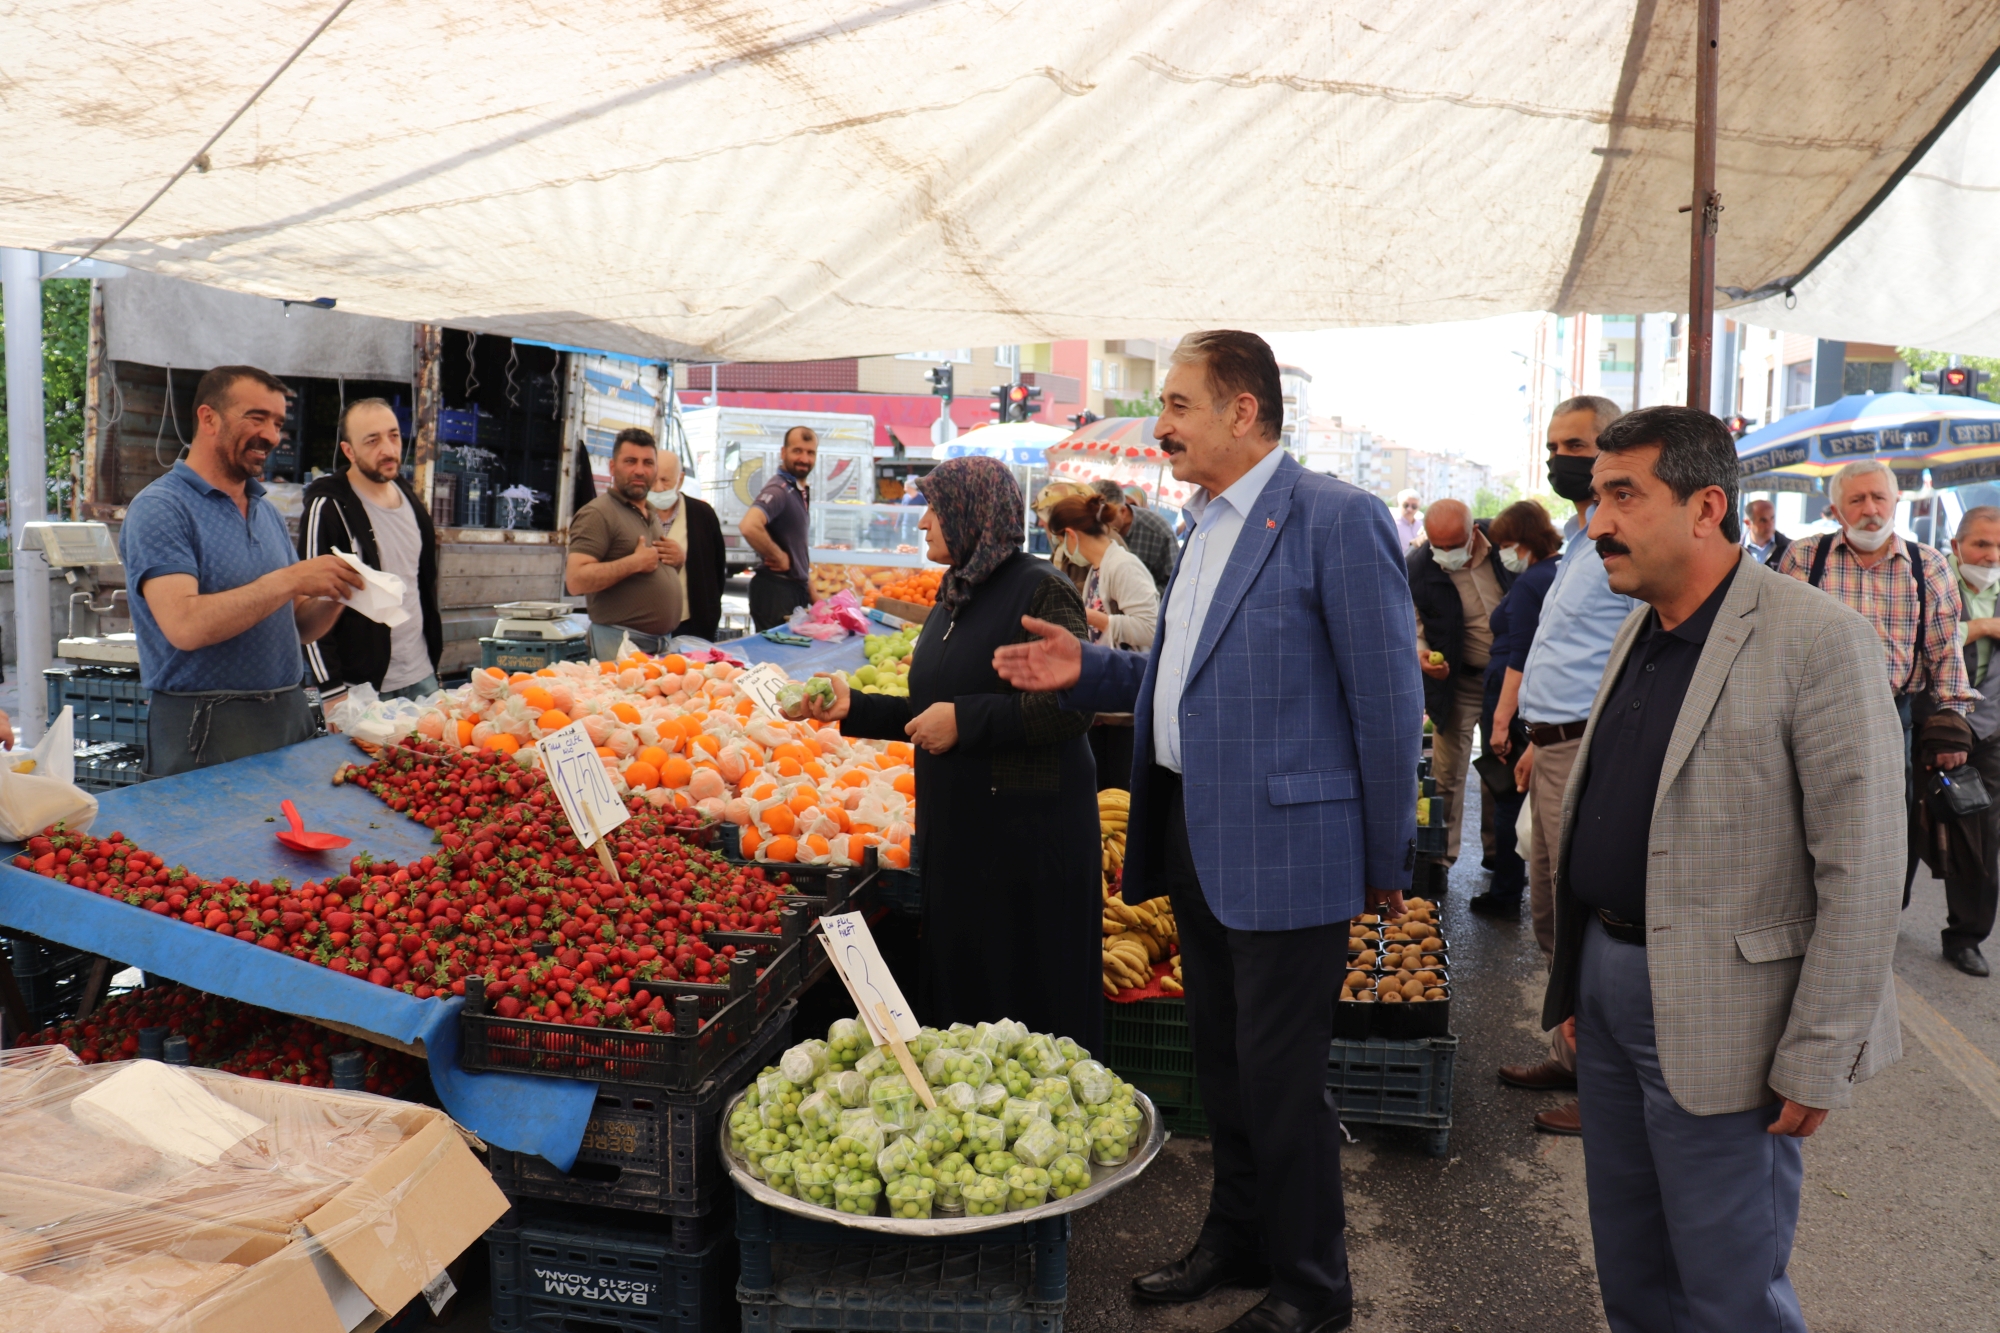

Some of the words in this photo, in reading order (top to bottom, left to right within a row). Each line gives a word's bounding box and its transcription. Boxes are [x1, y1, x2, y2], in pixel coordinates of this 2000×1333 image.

[1830, 433, 1877, 455] EFES
[1880, 428, 1930, 447] Pilsen
[1954, 425, 1991, 441] EFES
[1770, 448, 1806, 467] Pilsen
[582, 1133, 635, 1153] BERE
[534, 1268, 592, 1285] ADANA
[545, 1280, 648, 1306] BAYRAM
